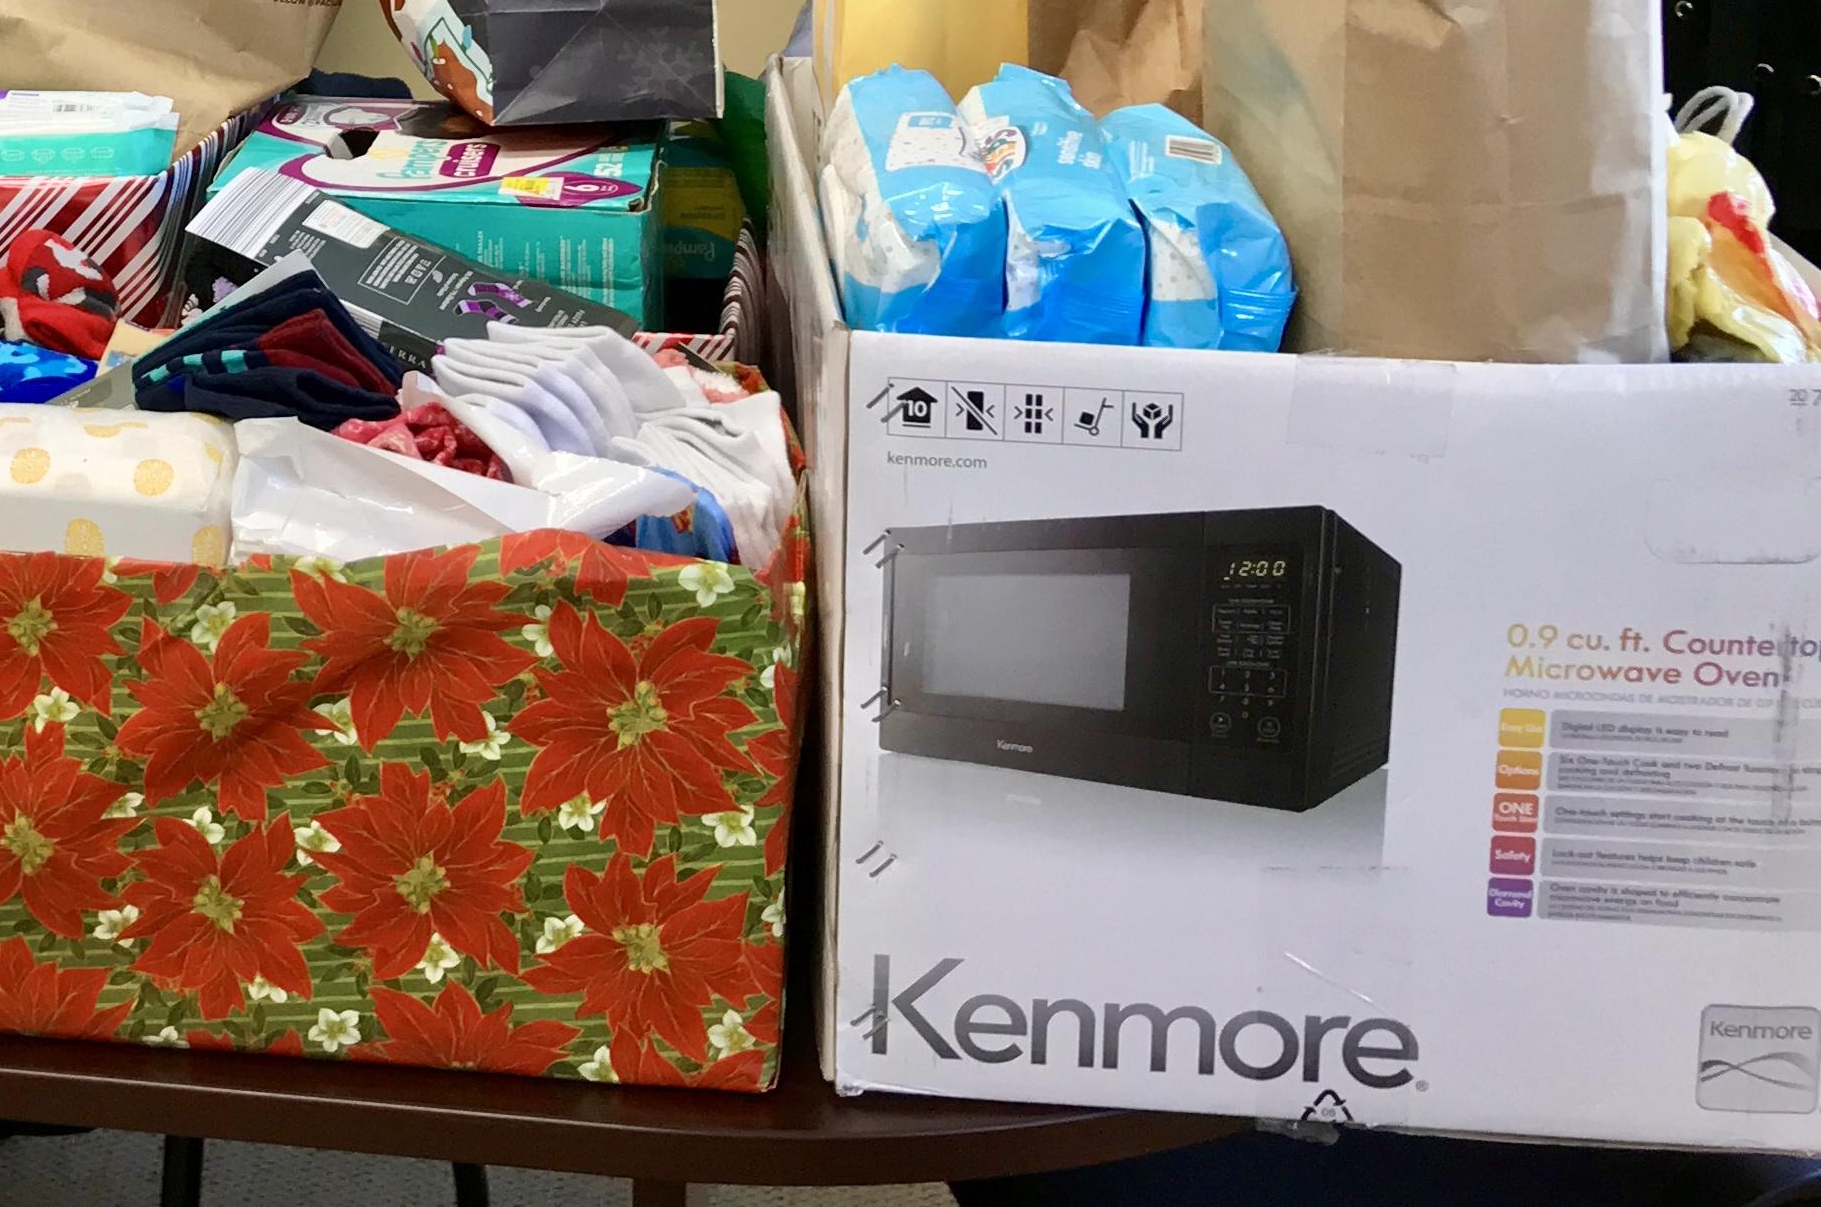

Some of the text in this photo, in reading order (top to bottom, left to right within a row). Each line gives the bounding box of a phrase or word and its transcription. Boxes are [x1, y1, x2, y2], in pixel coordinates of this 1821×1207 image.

[887, 451, 988, 470] kenmore.com
[1228, 560, 1287, 578] 12:00
[1506, 622, 1560, 650] 0.9
[1566, 631, 1610, 653] cu.
[1619, 628, 1650, 653] ft.
[1503, 654, 1781, 689] Microwave Oven
[1498, 801, 1534, 815] ONE
[1709, 1020, 1813, 1041] Kenmore
